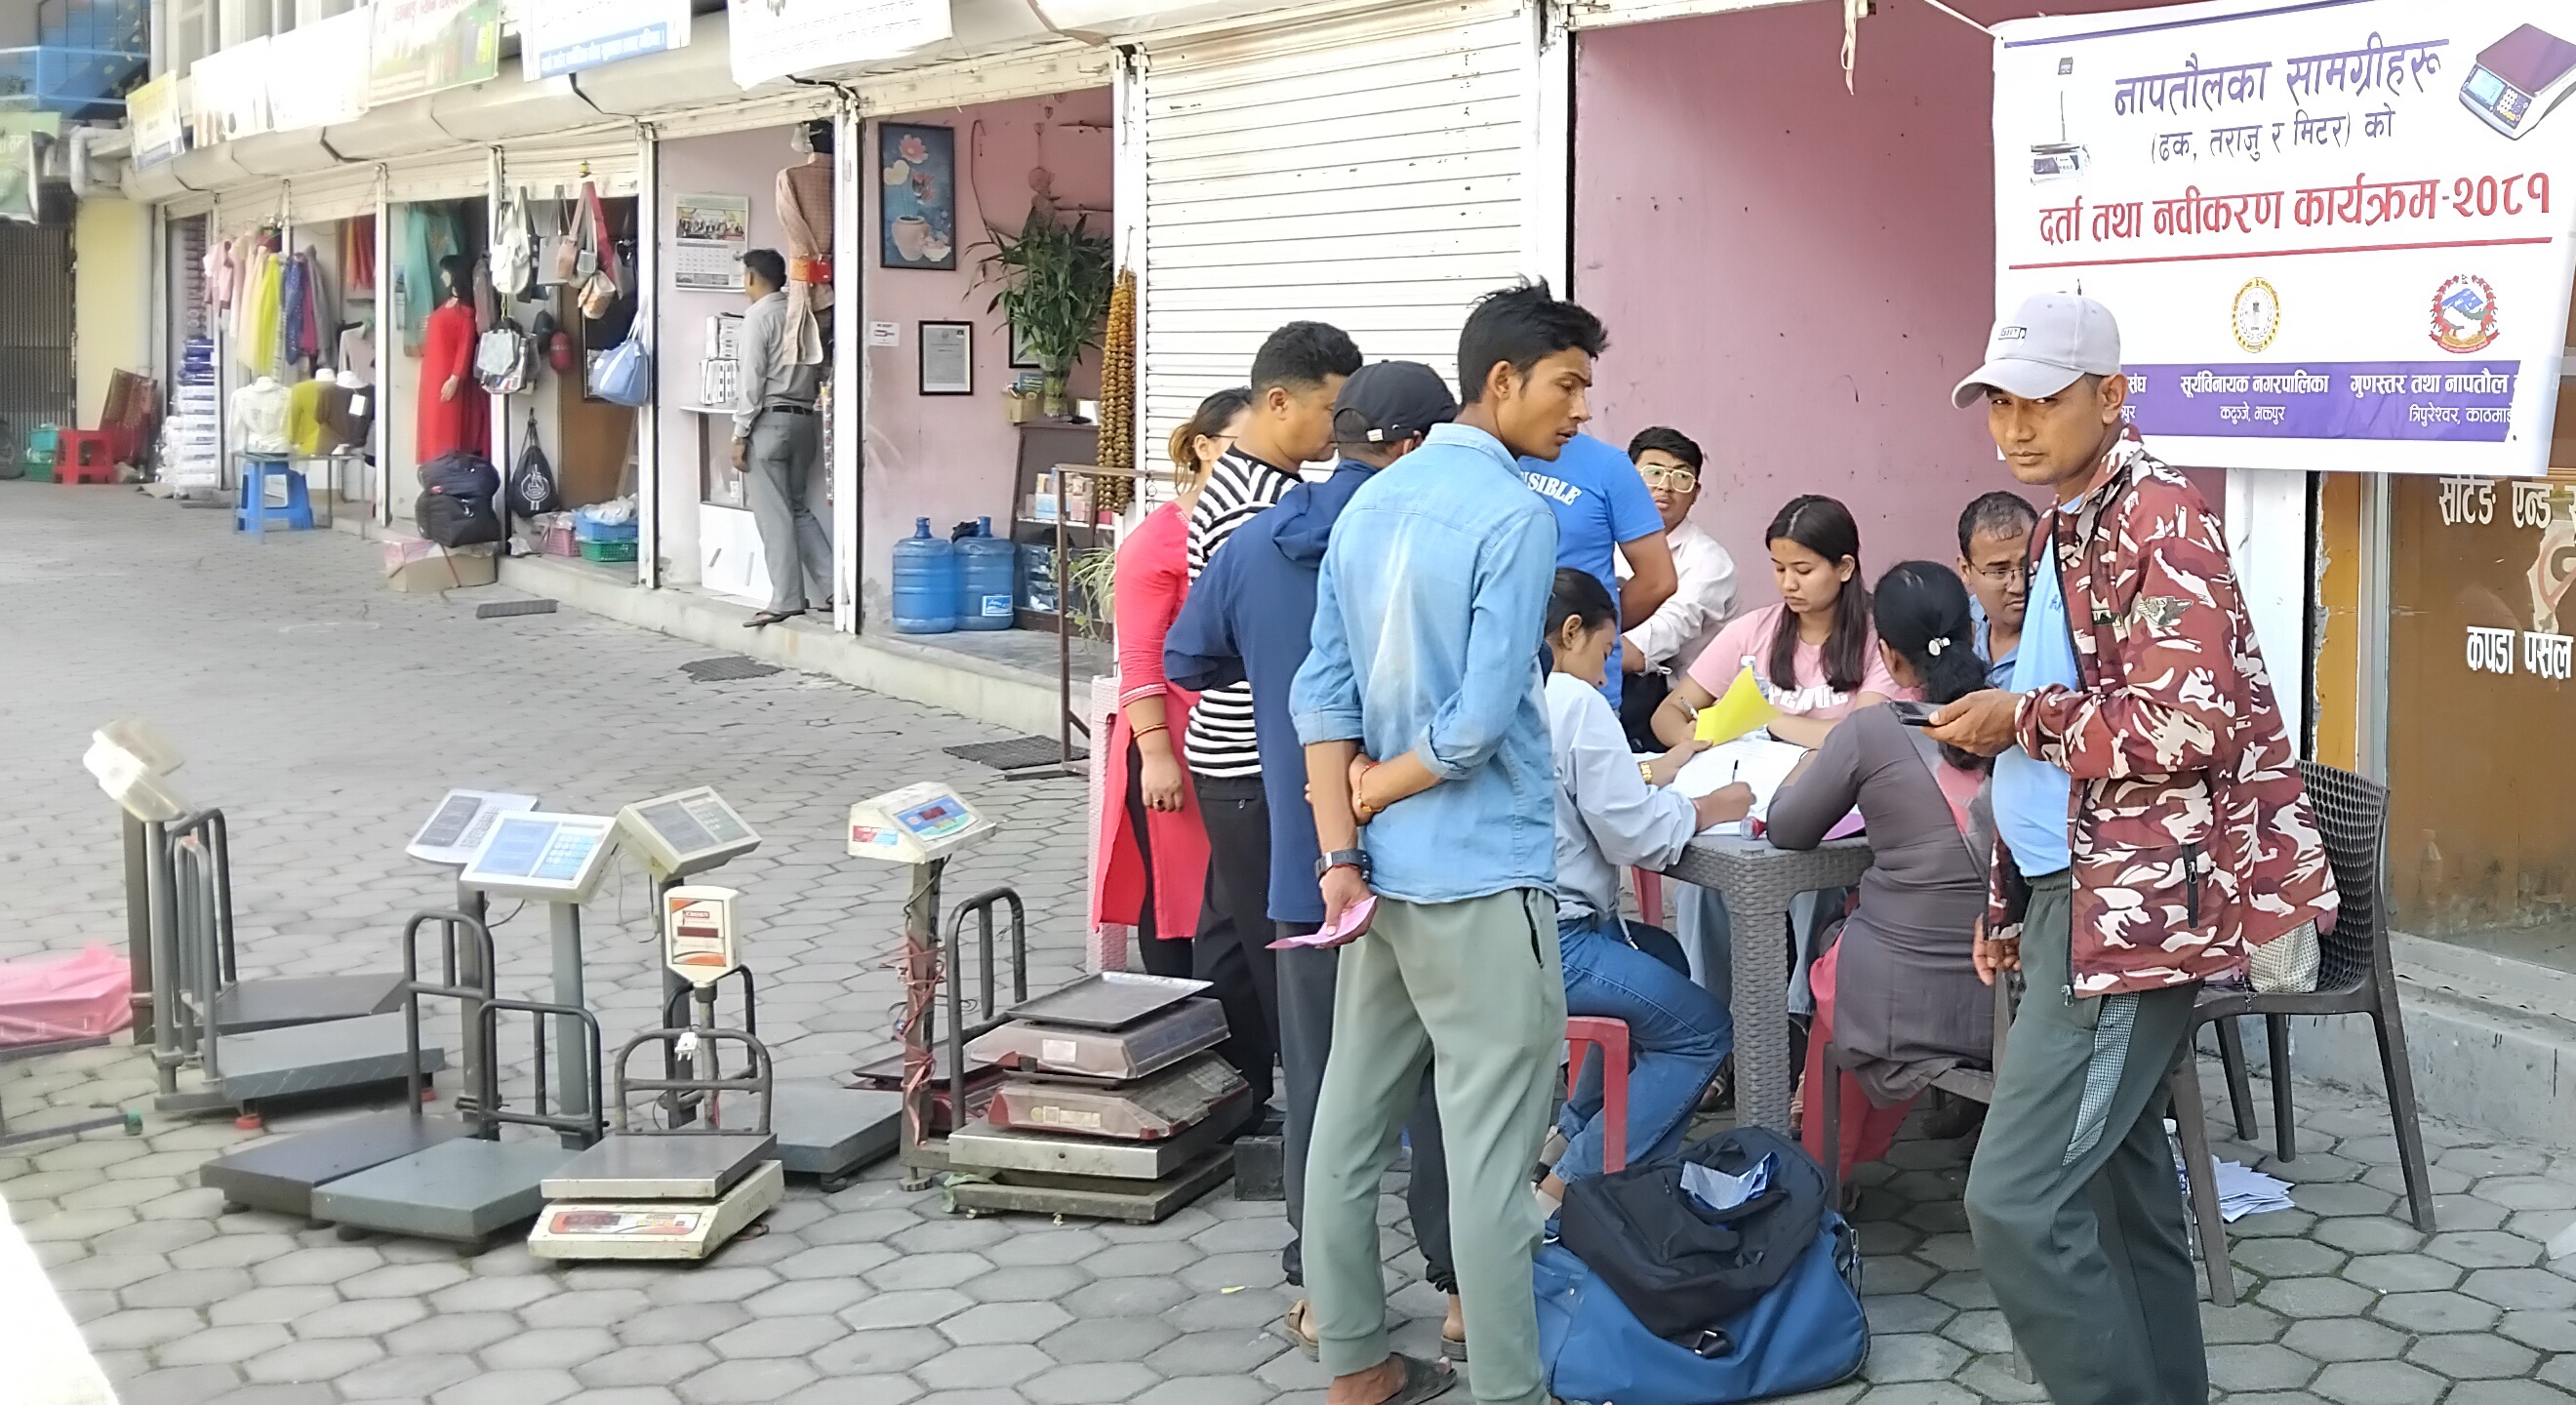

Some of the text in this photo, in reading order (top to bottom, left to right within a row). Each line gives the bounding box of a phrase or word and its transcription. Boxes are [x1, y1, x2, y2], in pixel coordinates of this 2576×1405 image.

[2114, 31, 2449, 115] नापतौलका सामग्रीहरू
[2210, 124, 2263, 162] तराजु
[2272, 122, 2285, 153] र
[2293, 108, 2351, 148] मिटर)
[2364, 101, 2396, 139] को
[2039, 195, 2083, 246] दर्ता
[2092, 202, 2144, 242] तथा
[2153, 185, 2284, 236] नवीकरण
[2180, 369, 2329, 398] सूर्यविनायक नगरपालिका
[2350, 374, 2407, 398] गुणस्तर
[2411, 374, 2441, 393] तथा
[2444, 367, 2509, 394] नापतौल
[2409, 402, 2461, 426] त्रिपुरेश्वर,
[2467, 625, 2574, 680] कपडा पसल
